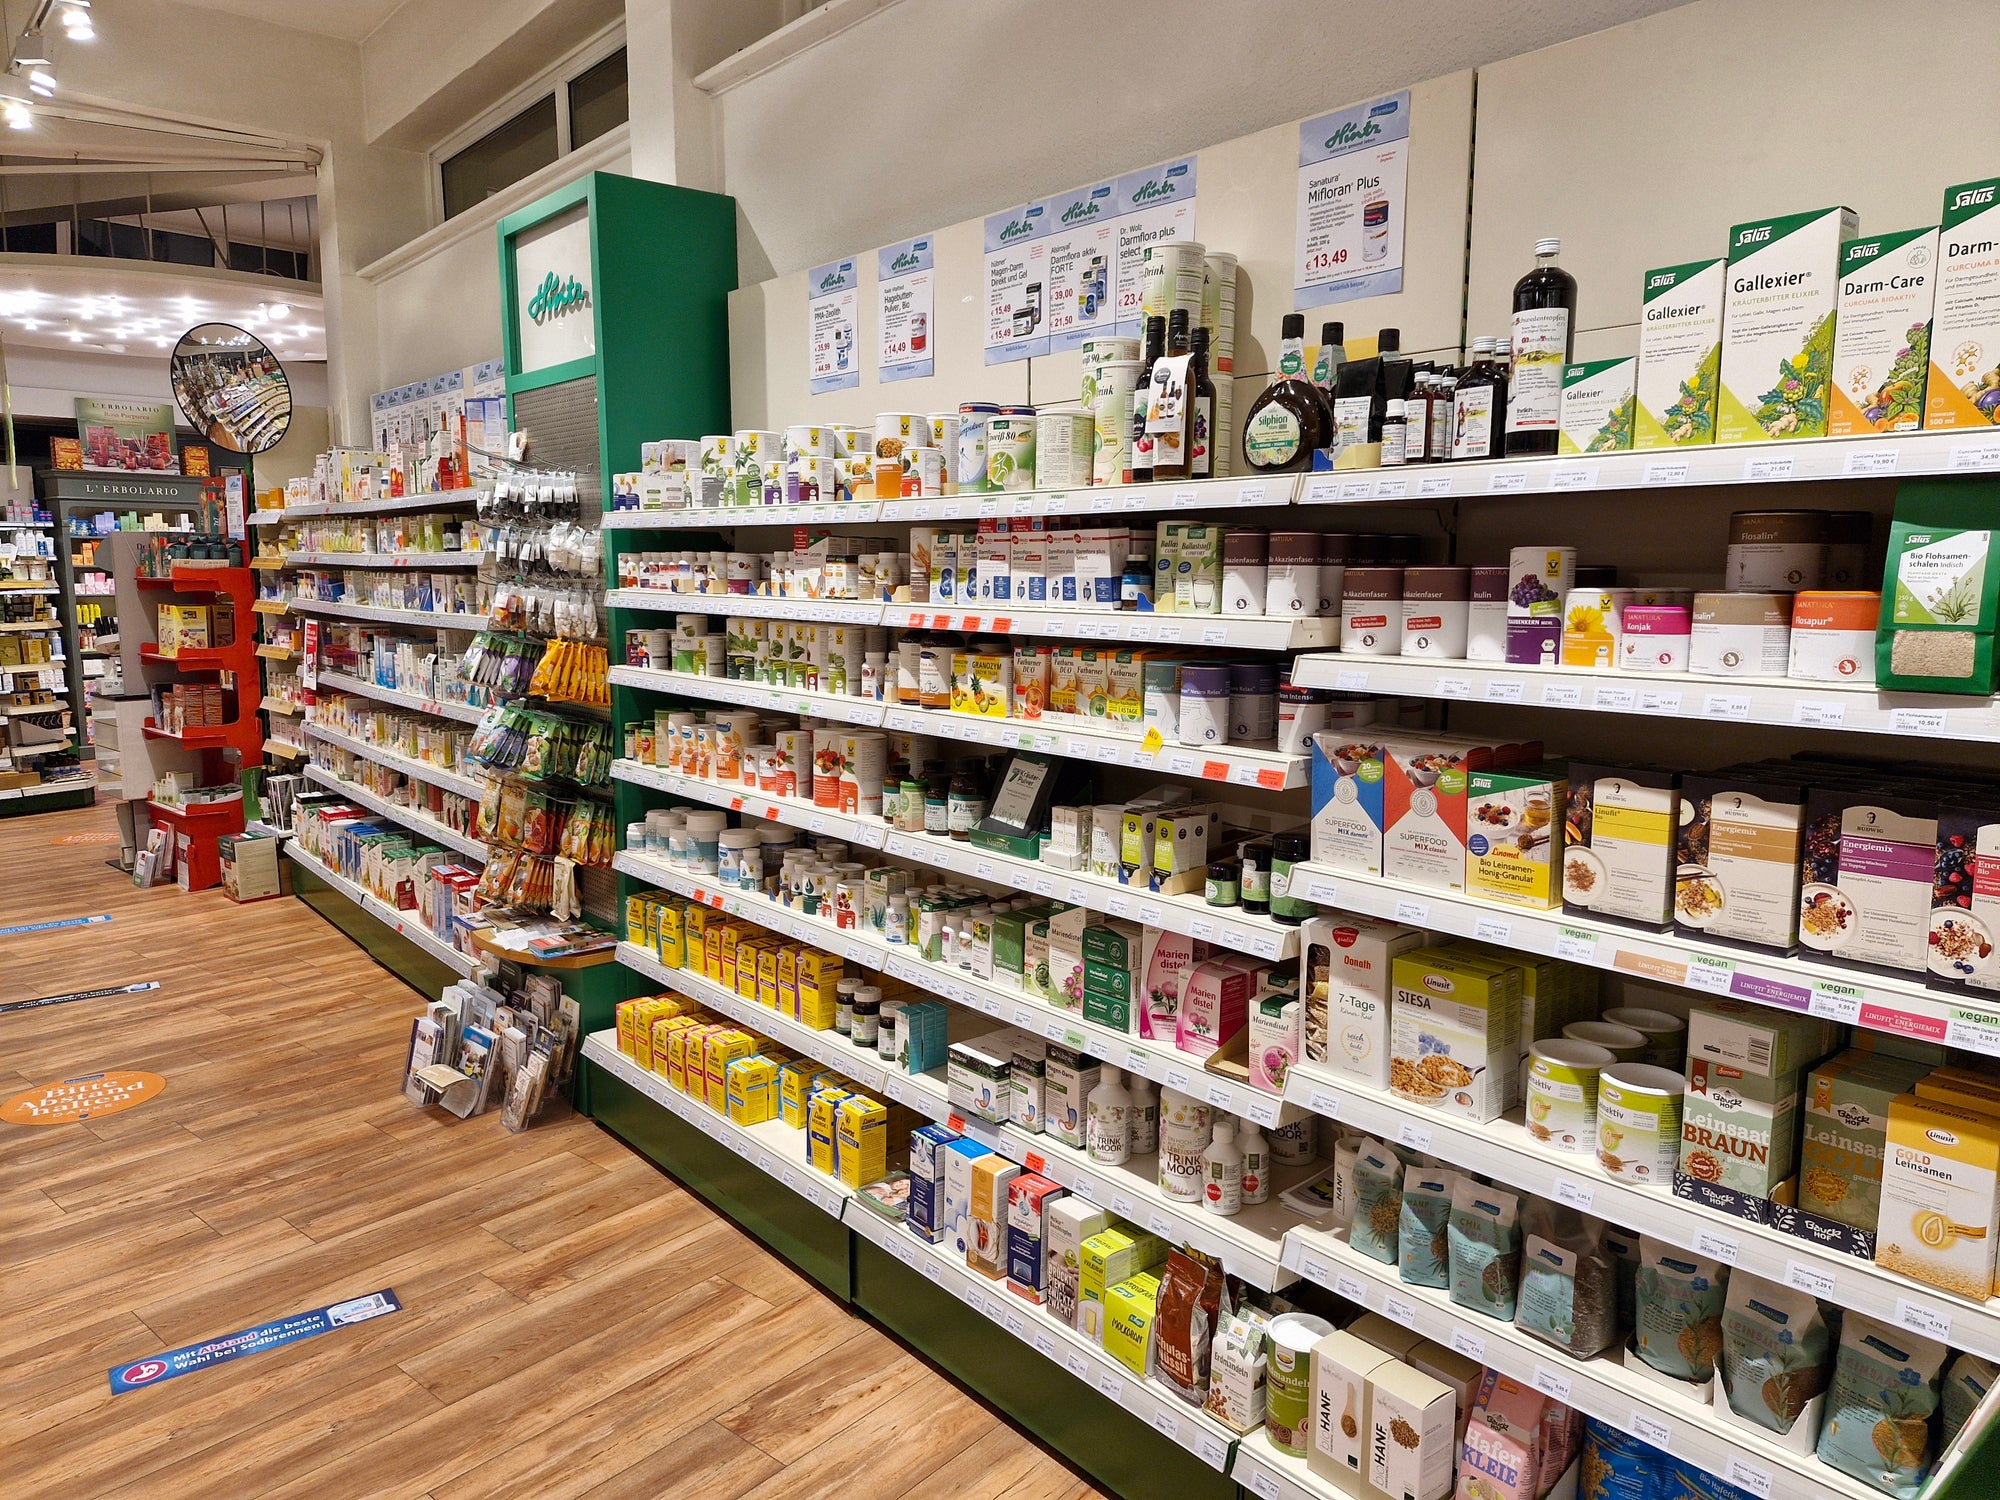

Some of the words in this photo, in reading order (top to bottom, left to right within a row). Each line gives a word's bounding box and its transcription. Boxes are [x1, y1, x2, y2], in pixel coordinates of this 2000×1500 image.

[1325, 121, 1382, 148] Hintz
[1356, 175, 1380, 192] Plus
[1950, 186, 1996, 210] Salus
[1130, 224, 1142, 232] Wolz
[1120, 231, 1157, 247] Darmflora
[1160, 226, 1176, 240] plus
[1734, 226, 1772, 246] Salus
[1051, 251, 1080, 265] Darmflora
[1082, 247, 1096, 258] aktiv
[1120, 248, 1141, 259] select
[1846, 242, 1880, 262] Salus
[1948, 240, 1998, 258] Darm-
[1306, 261, 1310, 270] €
[1313, 249, 1348, 270] 13,49
[991, 262, 1023, 277] Magen-Darm
[1051, 264, 1074, 275] FORTE
[991, 276, 1006, 286] Direkt
[1008, 273, 1018, 282] und
[1648, 272, 1676, 290] Salus
[1844, 276, 1924, 296] Darm-Care
[528, 271, 584, 319] Hintz
[1054, 289, 1073, 300] 39,00
[1732, 293, 1790, 307] KRÄUTERBITTER
[1792, 290, 1820, 298] ELIXIER
[1844, 298, 1878, 308] CURCUMA
[1881, 293, 1916, 304] BIOAKTIV
[1054, 317, 1072, 328] 21,50
[1566, 366, 1585, 378] Salus
[1258, 415, 1288, 427] Silphion
[1930, 417, 1943, 426] 500
[1944, 416, 1955, 424] ml
[86, 484, 179, 496] L'ERBOLARIO
[1905, 534, 1932, 544] Salus
[1182, 542, 1211, 552] Ballaststoff
[1274, 556, 1314, 564] Akazienfaser
[1925, 552, 1972, 560] Flohsamen-
[1474, 591, 1492, 600] Inulin
[1626, 623, 1652, 632] Konjak
[972, 661, 1002, 670] GRANOZYM
[1016, 658, 1042, 667] Fatburner
[1022, 666, 1035, 674] DUO
[1060, 666, 1072, 674] DUO
[1076, 666, 1104, 676] Fatburner
[1110, 668, 1138, 678] Fatburner
[1148, 730, 1159, 740] NEU
[1018, 776, 1034, 786] Pulver
[1020, 770, 1040, 782] Kräuter-
[1470, 778, 1492, 789] Salus
[1324, 818, 1367, 832] SUPERFOOD
[1338, 828, 1350, 836] MIX
[1712, 822, 1758, 836] Energiemix
[1856, 826, 1884, 834] BUDWIG
[1400, 832, 1448, 847] SUPERFOOD
[1414, 842, 1428, 851] MIX
[1429, 846, 1448, 854] classic
[1490, 846, 1520, 860] Linomel
[1842, 840, 1894, 854] Energiemix
[1480, 858, 1491, 866] Bio
[1493, 860, 1535, 874] Leinsamen-
[1478, 866, 1534, 884] Honig-Granulat
[1052, 929, 1082, 942] Mariendistel
[1565, 928, 1592, 940] vegan
[1157, 949, 1190, 960] Marien
[1160, 960, 1186, 970] distel
[1344, 955, 1371, 970] Donath
[1698, 956, 1728, 968] vegan
[1426, 978, 1451, 990] Linusit
[1820, 982, 1855, 995] vegan
[1190, 986, 1216, 1001] Marien
[1398, 990, 1432, 1010] SIESA
[1766, 988, 1808, 1003] ENERGIEMIX
[1192, 998, 1214, 1010] distel
[1338, 993, 1376, 1012] 7-Tage
[1252, 1015, 1289, 1032] Mariendistel
[1958, 1010, 1999, 1024] vegan
[1895, 1018, 1941, 1034] ENERGIEMIX
[16, 1081, 144, 1112] Abstand
[45, 1080, 118, 1099] Bitte
[32, 1092, 131, 1117] halten
[1712, 1094, 1743, 1108] Bauck
[1837, 1109, 1870, 1125] Bauck
[1914, 1102, 1979, 1123] Leinsamen
[1684, 1107, 1770, 1146] Leinsaat
[1845, 1118, 1860, 1126] HOF
[840, 1122, 855, 1138] Luvos
[1097, 1136, 1121, 1146] TRINK
[1682, 1123, 1768, 1164] BRAUN
[1928, 1132, 1956, 1144] Linusit
[1097, 1144, 1122, 1152] MOOR
[1167, 1152, 1201, 1166] TRINK
[1726, 1156, 1768, 1172] geschrotet
[1896, 1148, 1931, 1166] GOLD
[1166, 1162, 1202, 1176] MOOR
[1894, 1157, 1952, 1181] Leinsamen
[1702, 1186, 1735, 1204] Bauck
[1710, 1196, 1726, 1206] HOF
[1804, 1220, 1842, 1240] Bauck
[1814, 1232, 1832, 1241] HOF
[1815, 1280, 1828, 1288] 2,29
[1929, 1320, 1942, 1329] 4,79
[172, 1350, 197, 1363] Mit
[200, 1332, 256, 1354] Abstand
[259, 1324, 280, 1338] die
[284, 1314, 321, 1331] beste
[174, 1354, 211, 1370] Wahl
[214, 1346, 238, 1360] bei
[240, 1320, 326, 1351] Sodbrennen!
[1214, 1351, 1249, 1379] Erdmandeln
[1486, 1414, 1509, 1432] Bauck
[1464, 1428, 1522, 1467] Hafer
[1461, 1444, 1518, 1490] KLEIE
